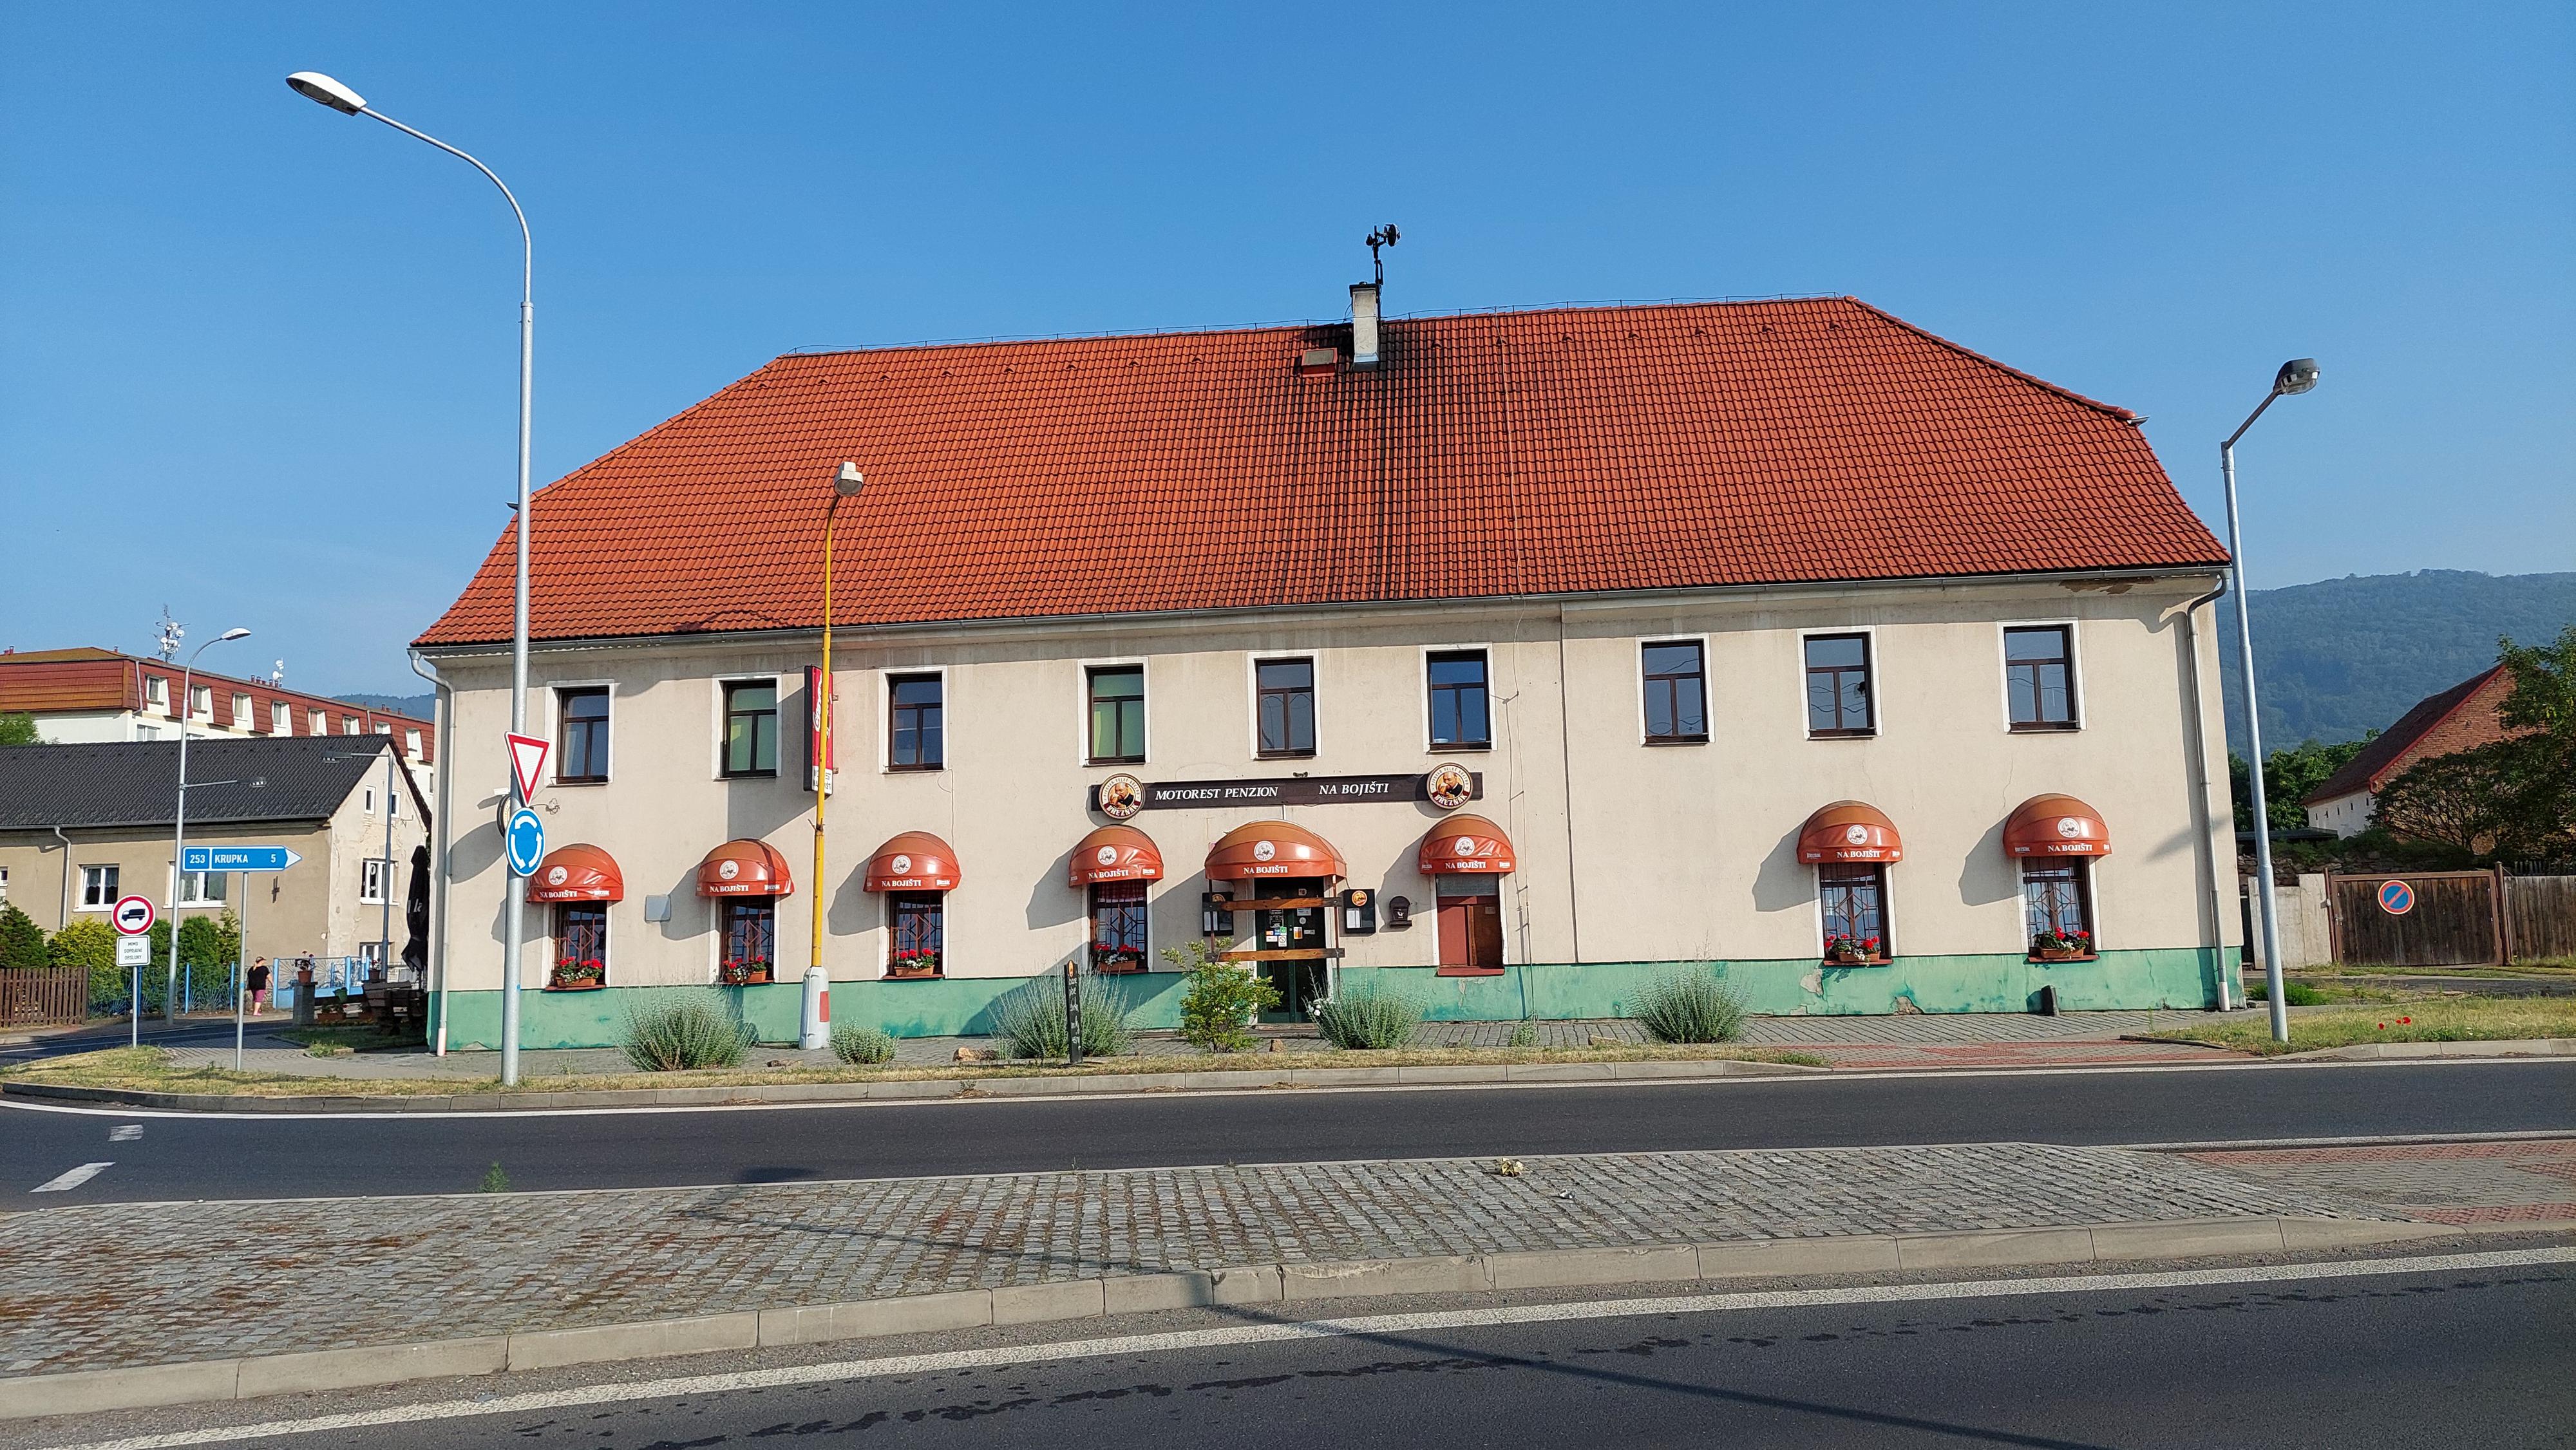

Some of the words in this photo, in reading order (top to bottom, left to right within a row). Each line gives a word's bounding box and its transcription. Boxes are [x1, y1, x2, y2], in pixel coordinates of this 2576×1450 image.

[1155, 788, 1221, 801] MOTOREST
[1224, 786, 1279, 798] PENZION
[1319, 784, 1338, 795] NA
[1341, 780, 1389, 795] BOJIŠTI
[2061, 842, 2093, 852] BOJIŠTI
[1850, 849, 1880, 858] BOJIŠTI
[189, 854, 206, 864] 253
[214, 854, 249, 863] KRUPKA
[270, 854, 276, 863] 5
[1256, 864, 1289, 874] BOJIŠTI
[1457, 860, 1486, 869] BOJIŠTI
[1099, 869, 1129, 878] BOJIŠTI
[891, 878, 922, 887] BOJIŠTI
[720, 883, 749, 892] BOJIŠTI
[549, 889, 578, 898] BOJIŠTI
